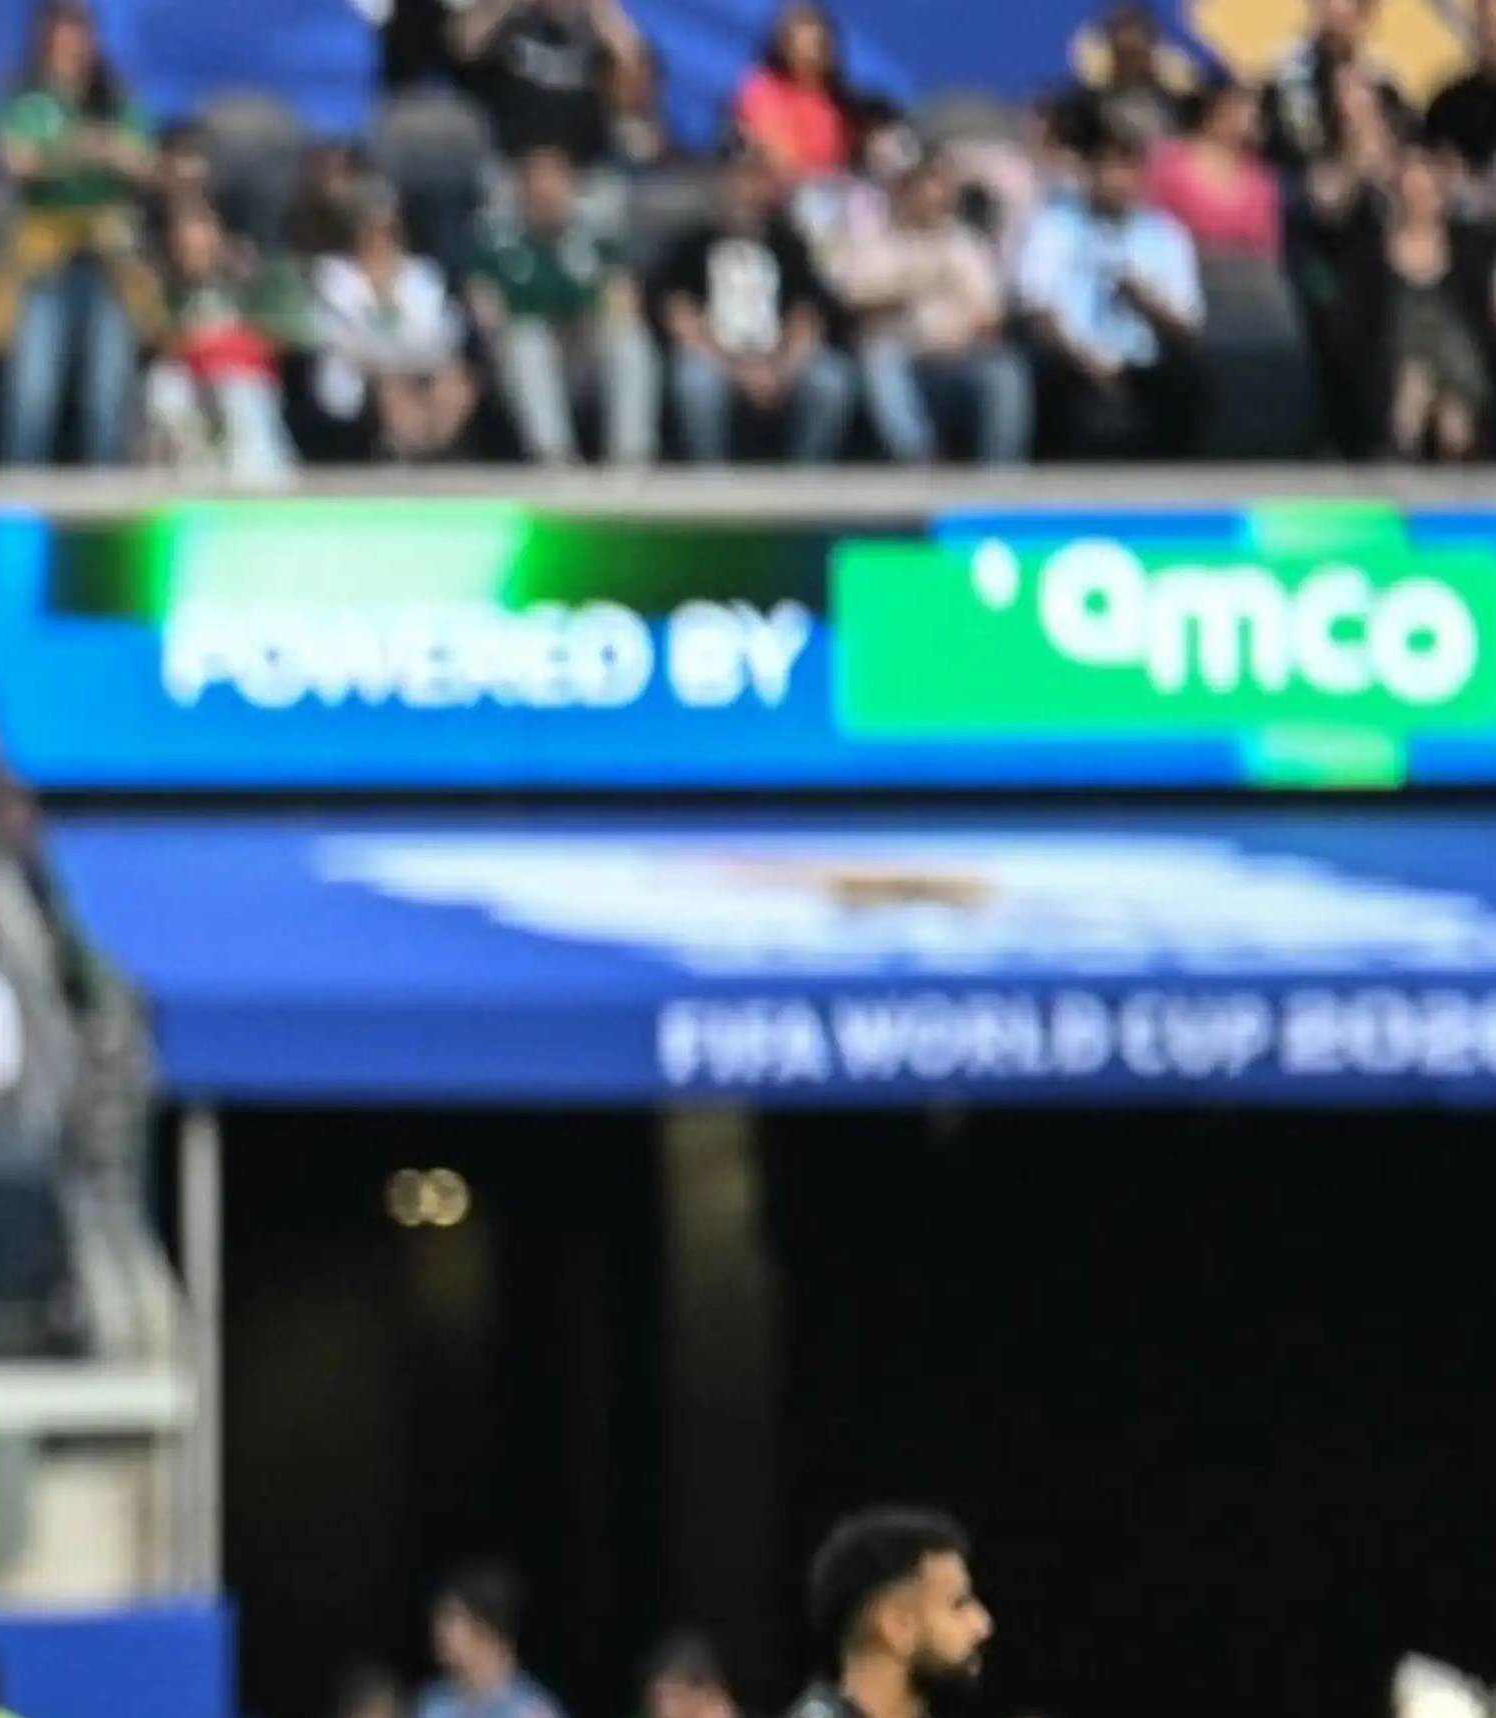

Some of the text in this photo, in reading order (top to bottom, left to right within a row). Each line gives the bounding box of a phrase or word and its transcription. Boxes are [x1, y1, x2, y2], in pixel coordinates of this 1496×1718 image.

[160, 597, 812, 708] POWERED BY
[832, 990, 1111, 1080] WORLD
[1121, 990, 1272, 1079] CUP
